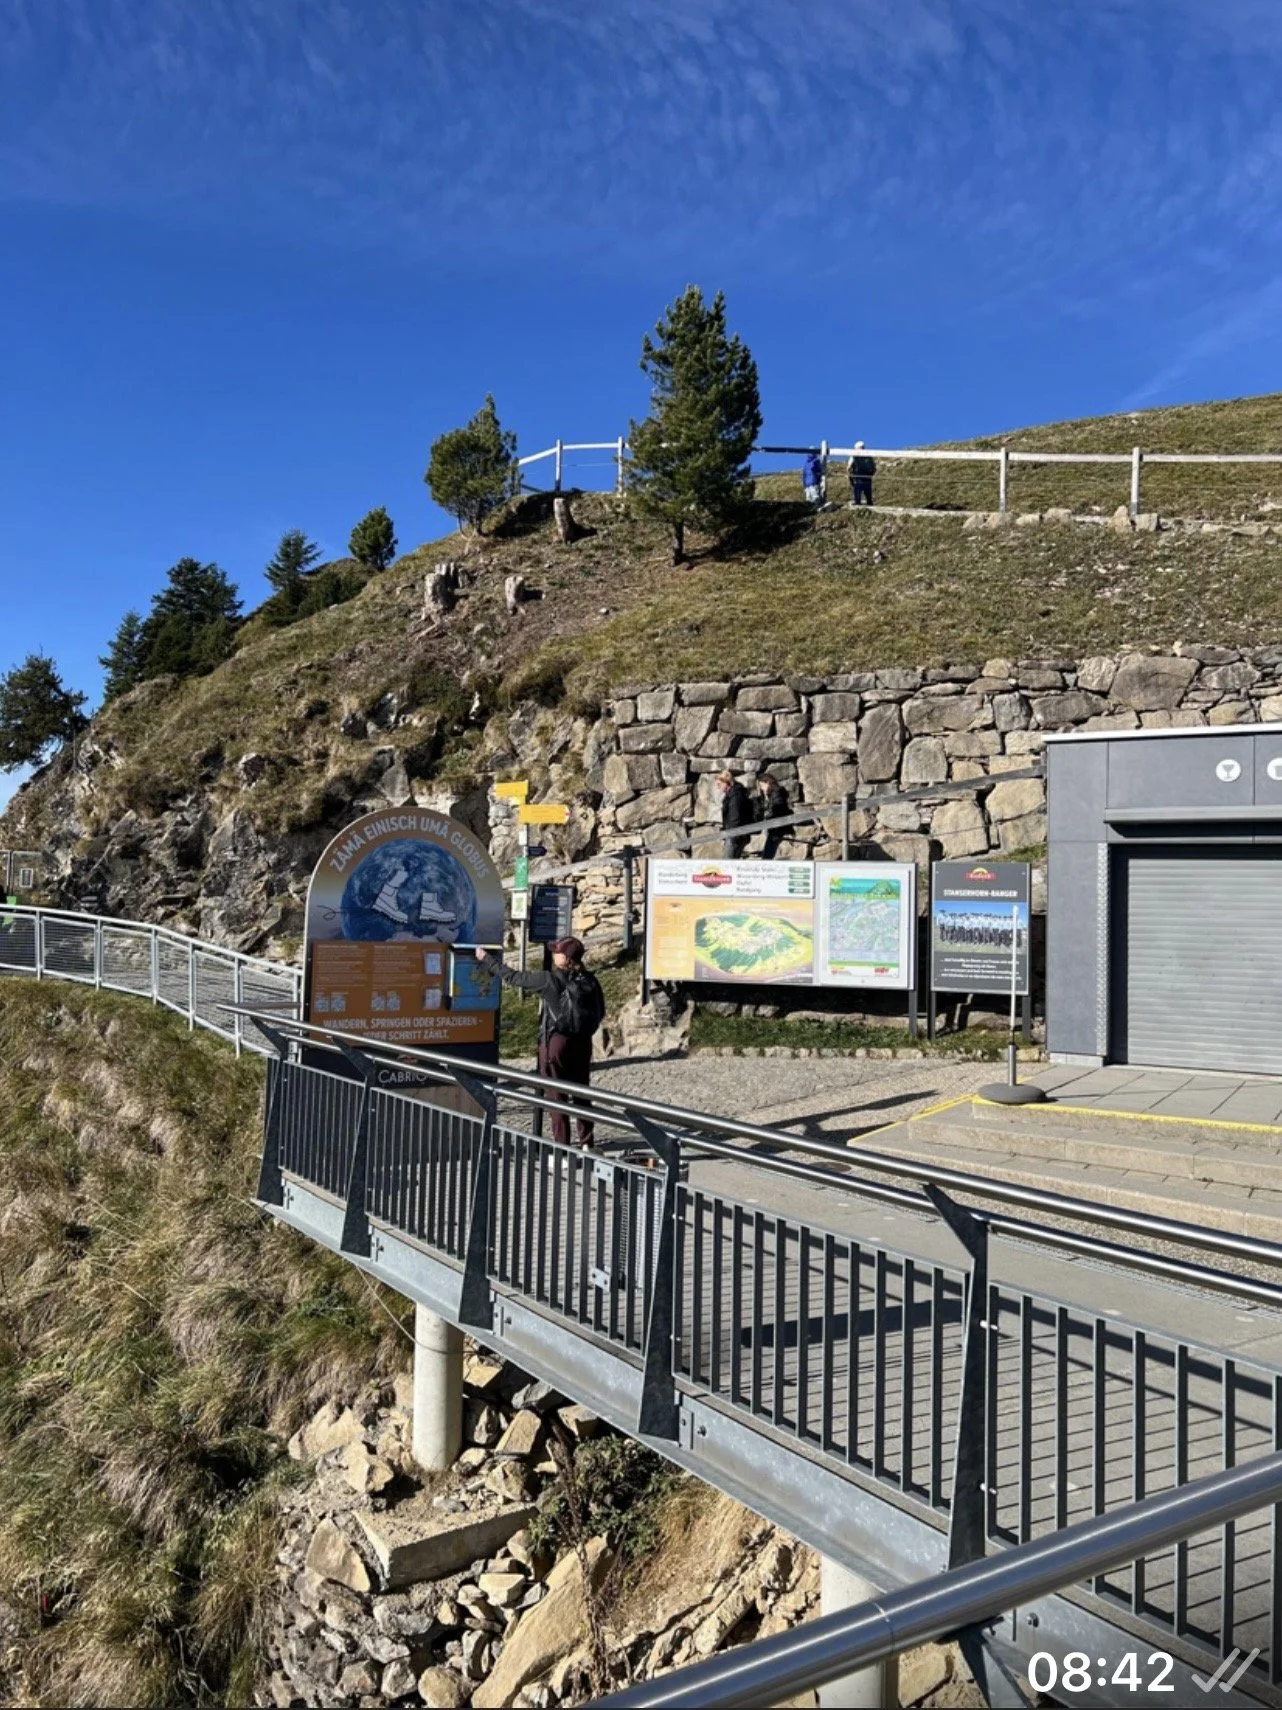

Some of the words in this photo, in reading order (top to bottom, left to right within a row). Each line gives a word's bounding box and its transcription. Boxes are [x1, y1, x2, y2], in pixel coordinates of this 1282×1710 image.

[329, 830, 366, 873] ZÄMÄ
[363, 815, 417, 841] EINISCH
[420, 816, 450, 839] UMÄ
[450, 831, 489, 878] GLOBUS
[371, 1017, 411, 1029] SPRINGEN
[414, 1016, 434, 1028] ODER
[436, 1015, 478, 1027] SPAZIEREN
[388, 1030, 421, 1041] SCHRITT
